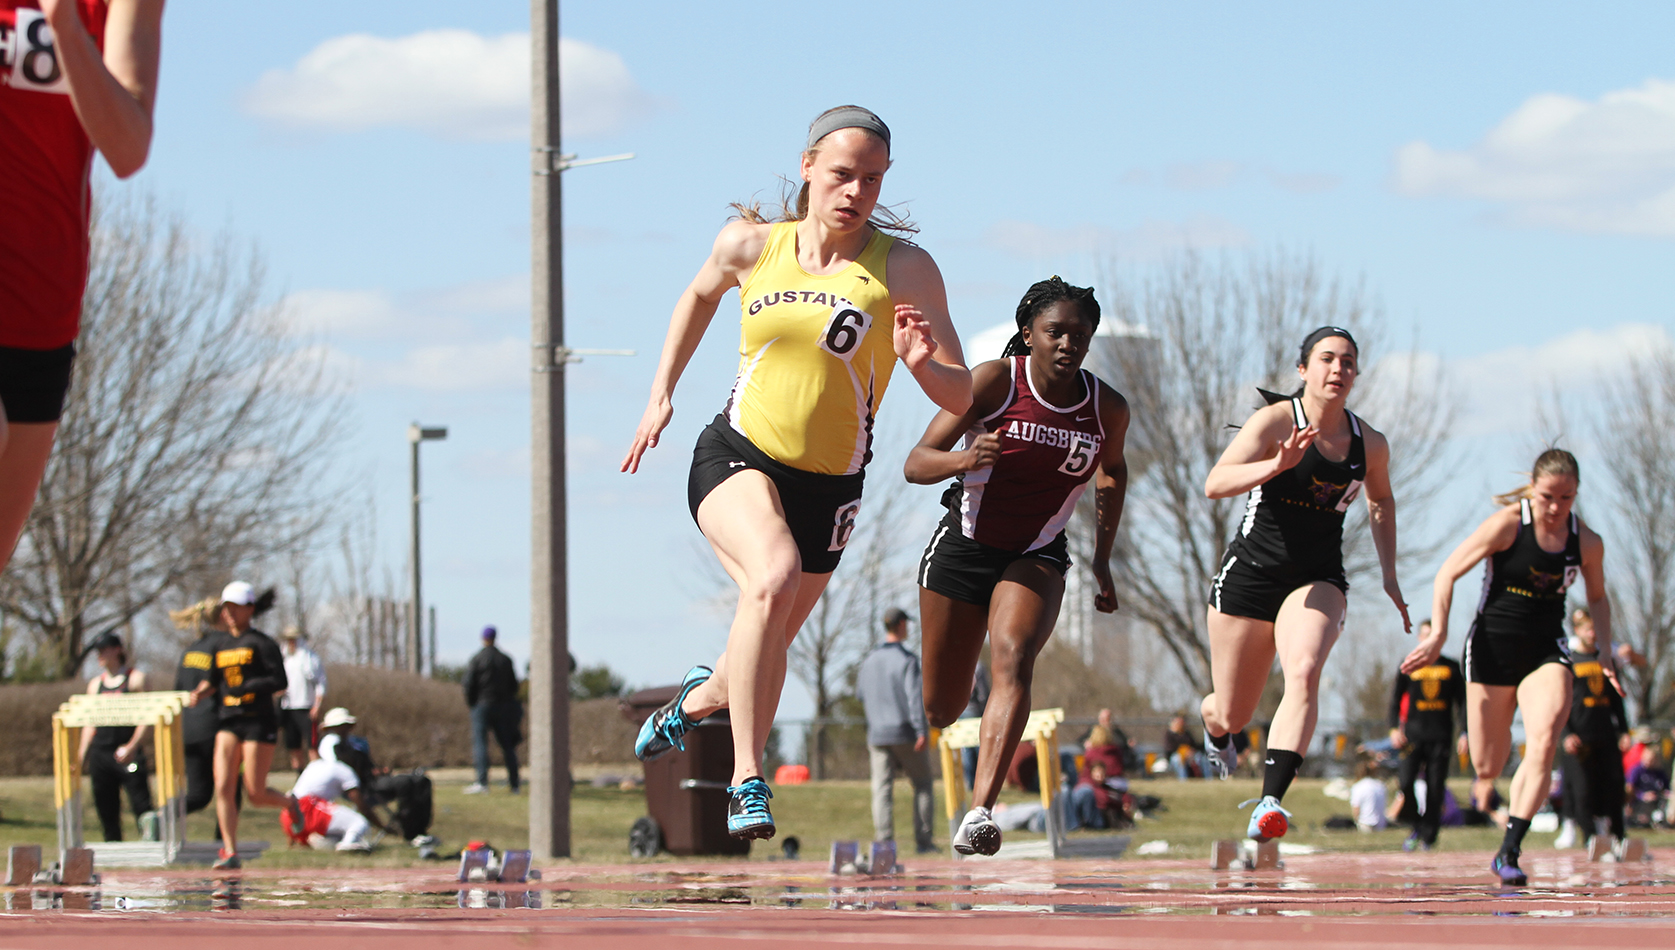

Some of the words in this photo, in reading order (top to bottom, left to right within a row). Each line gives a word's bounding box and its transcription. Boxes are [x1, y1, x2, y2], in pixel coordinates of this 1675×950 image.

[22, 17, 62, 84] 8
[748, 290, 866, 321] GUSTAV
[825, 309, 865, 355] 6
[1065, 440, 1092, 473] 5
[836, 504, 858, 548] 6
